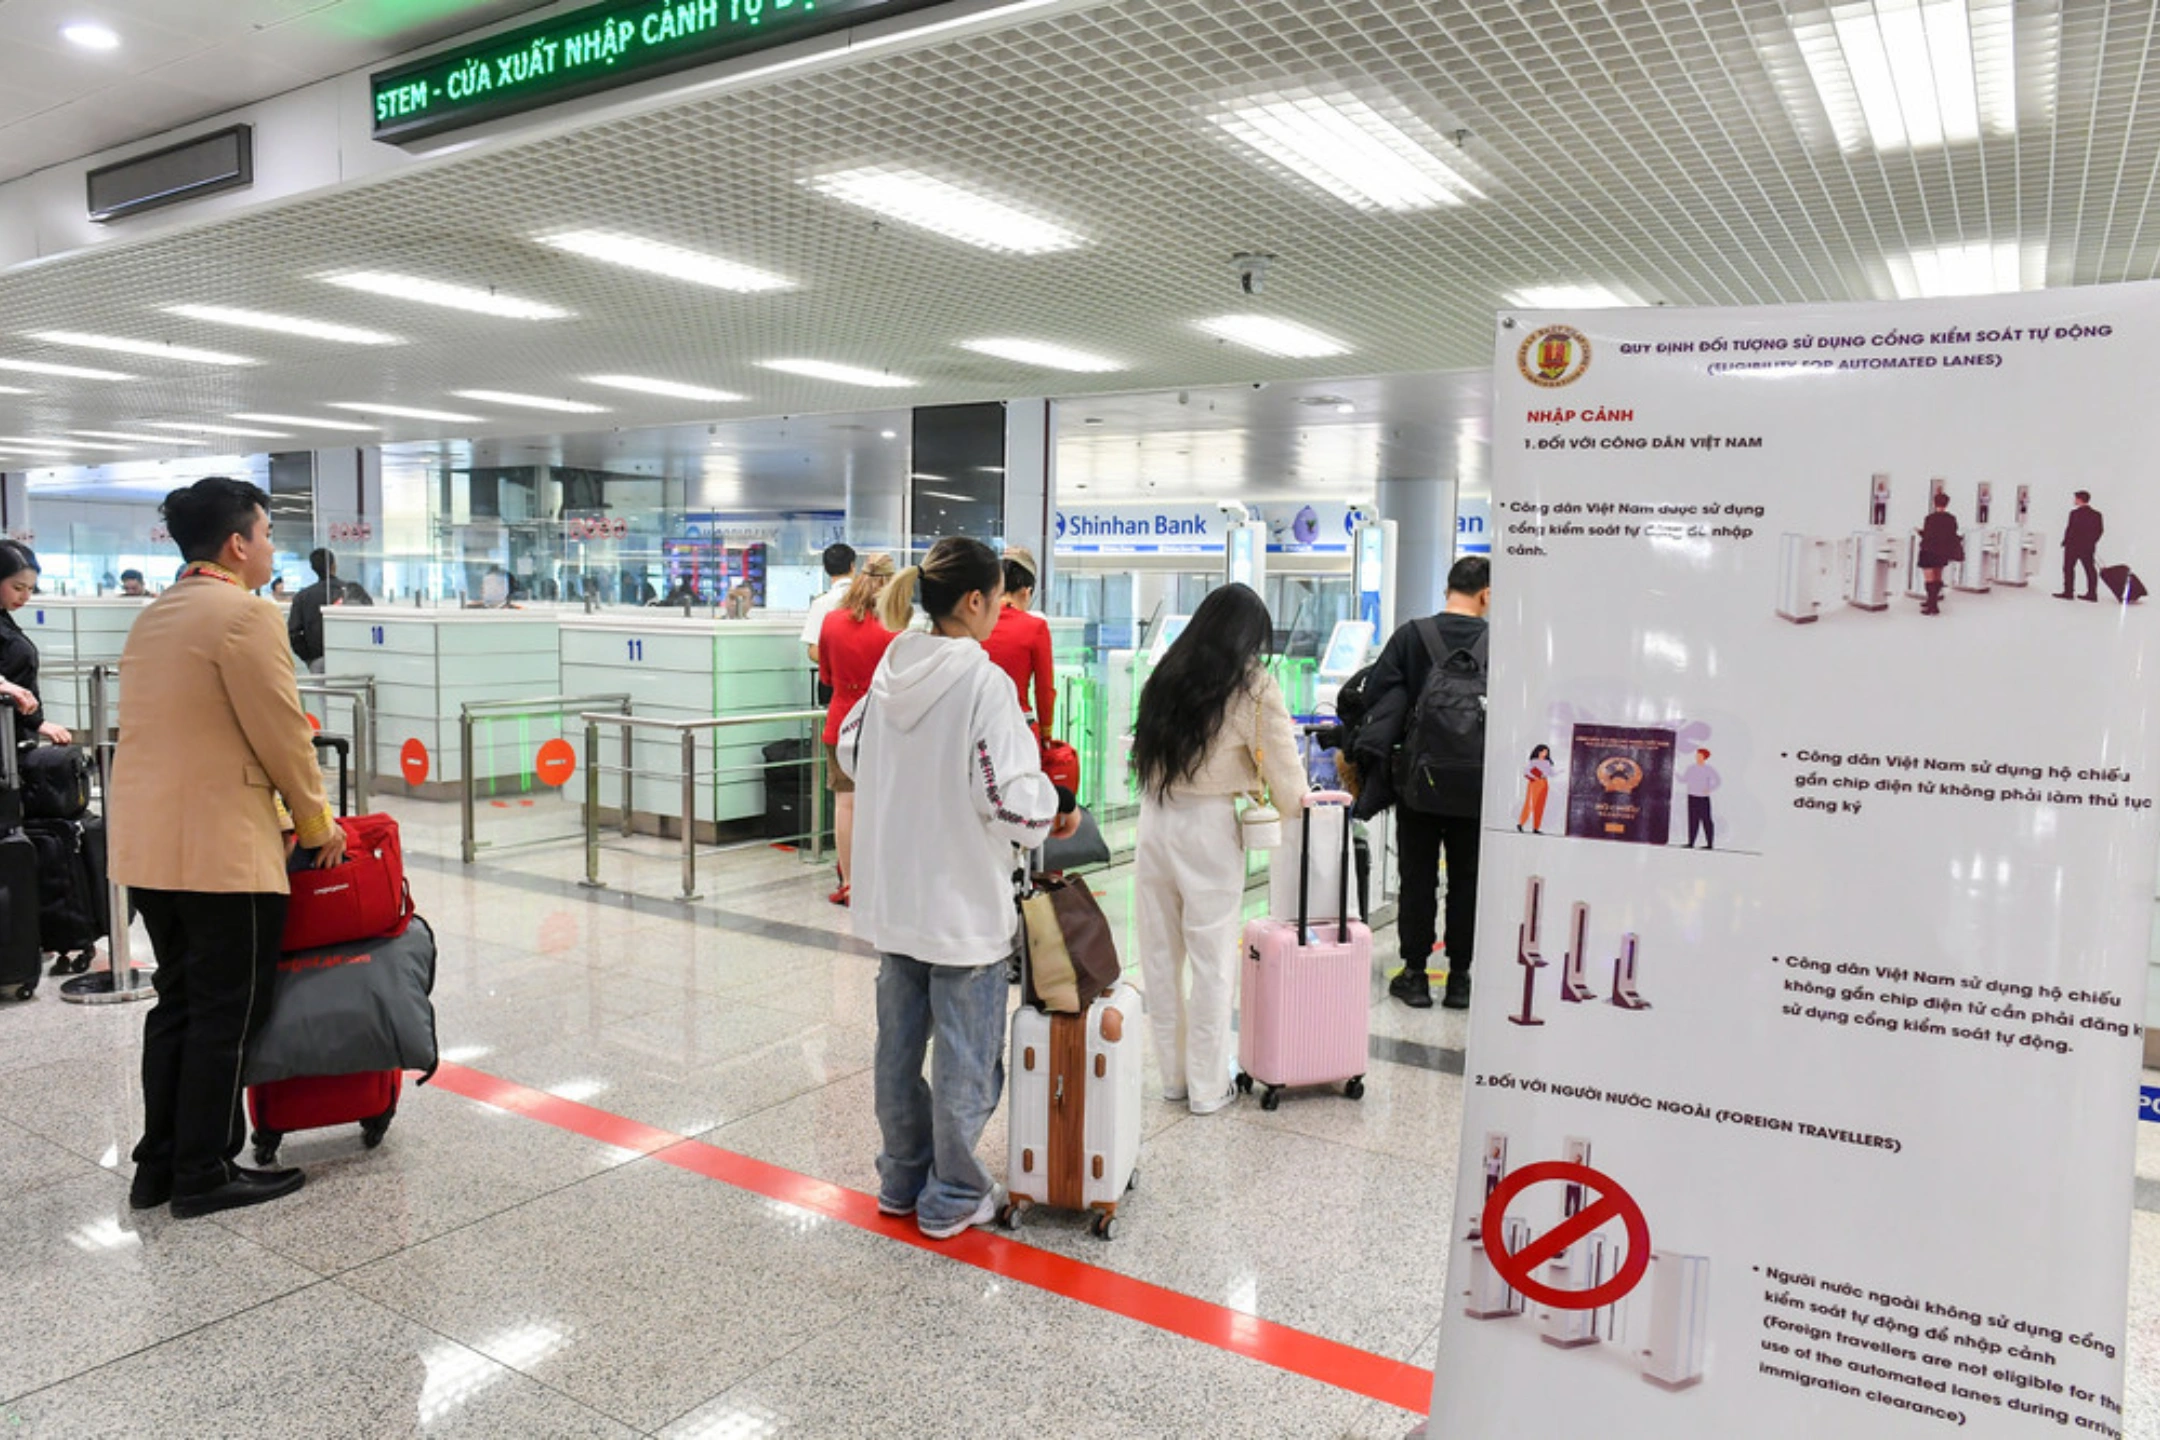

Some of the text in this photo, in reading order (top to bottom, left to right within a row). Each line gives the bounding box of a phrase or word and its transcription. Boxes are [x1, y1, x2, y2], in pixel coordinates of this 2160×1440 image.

[377, 81, 427, 120] STEM
[448, 58, 492, 100] CỬA
[497, 37, 558, 87] XUẤT
[565, 17, 635, 67] NHẬP
[642, 0, 717, 44] CẢNH
[1656, 341, 1695, 356] ĐỊNH
[1699, 336, 1728, 352] ĐỐI
[1733, 338, 1788, 353] TƯỢNG
[1793, 334, 1814, 349] SỬ
[1817, 335, 1866, 351] DỤNG
[1871, 328, 1925, 346] CỔNG
[1930, 326, 1971, 345] KIỂM
[1976, 326, 2022, 342] SOÁT
[2028, 326, 2050, 341] TỰ
[2055, 323, 2113, 341] ĐỘNG
[1838, 356, 1937, 370] AUTOMATED
[1943, 353, 2003, 368] LANES)
[1526, 405, 1633, 425] NHẬP CẢNH
[1570, 436, 1596, 449] VỚI
[1600, 436, 1648, 449] CÔNG
[1652, 436, 1685, 448] DÂN
[1691, 434, 1721, 450] VIỆT
[1725, 436, 1763, 448] NAM
[1069, 513, 1207, 536] Shinhan Bank
[1510, 502, 1549, 516] Công
[1553, 502, 1582, 513] dân
[1586, 502, 1615, 515] Việt
[1619, 502, 1654, 514] Nam
[1702, 502, 1721, 514] sử
[1724, 503, 1765, 518] dụng
[1549, 521, 1585, 534] kiểm
[1588, 524, 1620, 536] soát
[1625, 525, 1641, 537] tự
[1712, 525, 1753, 540] nhập
[628, 639, 642, 661] 11
[1796, 750, 2131, 782] Công dân Việt Nam sử dụng hộ chiếu
[1793, 797, 1862, 815] đăng ký
[1832, 777, 1870, 791] chip
[1874, 779, 1912, 795] điện
[1917, 781, 1936, 794] tử
[1939, 783, 1996, 801] không
[2001, 787, 2042, 802] phải
[2047, 790, 2083, 804] làm
[2089, 793, 2119, 807] thủ
[2125, 795, 2152, 811] tục
[1786, 956, 2121, 1007] Công dân Việt Nam sử dụng hộ chiếu
[1784, 979, 1836, 999] không
[1880, 992, 1918, 1009] chip
[1923, 997, 1962, 1015] điện
[1968, 1001, 1987, 1015] tử
[2032, 1010, 2074, 1027] phải
[2079, 1016, 2129, 1037] đăng
[1782, 1002, 2074, 1054] sử dụng cổng kiểm soát tự động.
[1520, 1078, 1547, 1093] VỚI
[1551, 1084, 1602, 1101] NGƯỜI
[1606, 1091, 1653, 1108] NƯỚC
[1657, 1100, 1711, 1119] NGOÀI
[1715, 1109, 1793, 1132] (FOREIGN
[1798, 1121, 1902, 1153] TRAVELLERS)
[1764, 1290, 2057, 1366] kiểm soát tự động để nhập cảnh
[1766, 1266, 2116, 1359] Người nước ngoài không sử dụng cổng
[1763, 1314, 2122, 1415] (Foreign travellers are not eligible for the
[1759, 1361, 1967, 1426] immigration clearance)
[1761, 1339, 1790, 1355] use
[1794, 1347, 1811, 1360] of
[1815, 1350, 1842, 1367] the
[1847, 1360, 1946, 1393] automated
[1951, 1384, 2002, 1406] lanes
[2007, 1398, 2069, 1425] during
